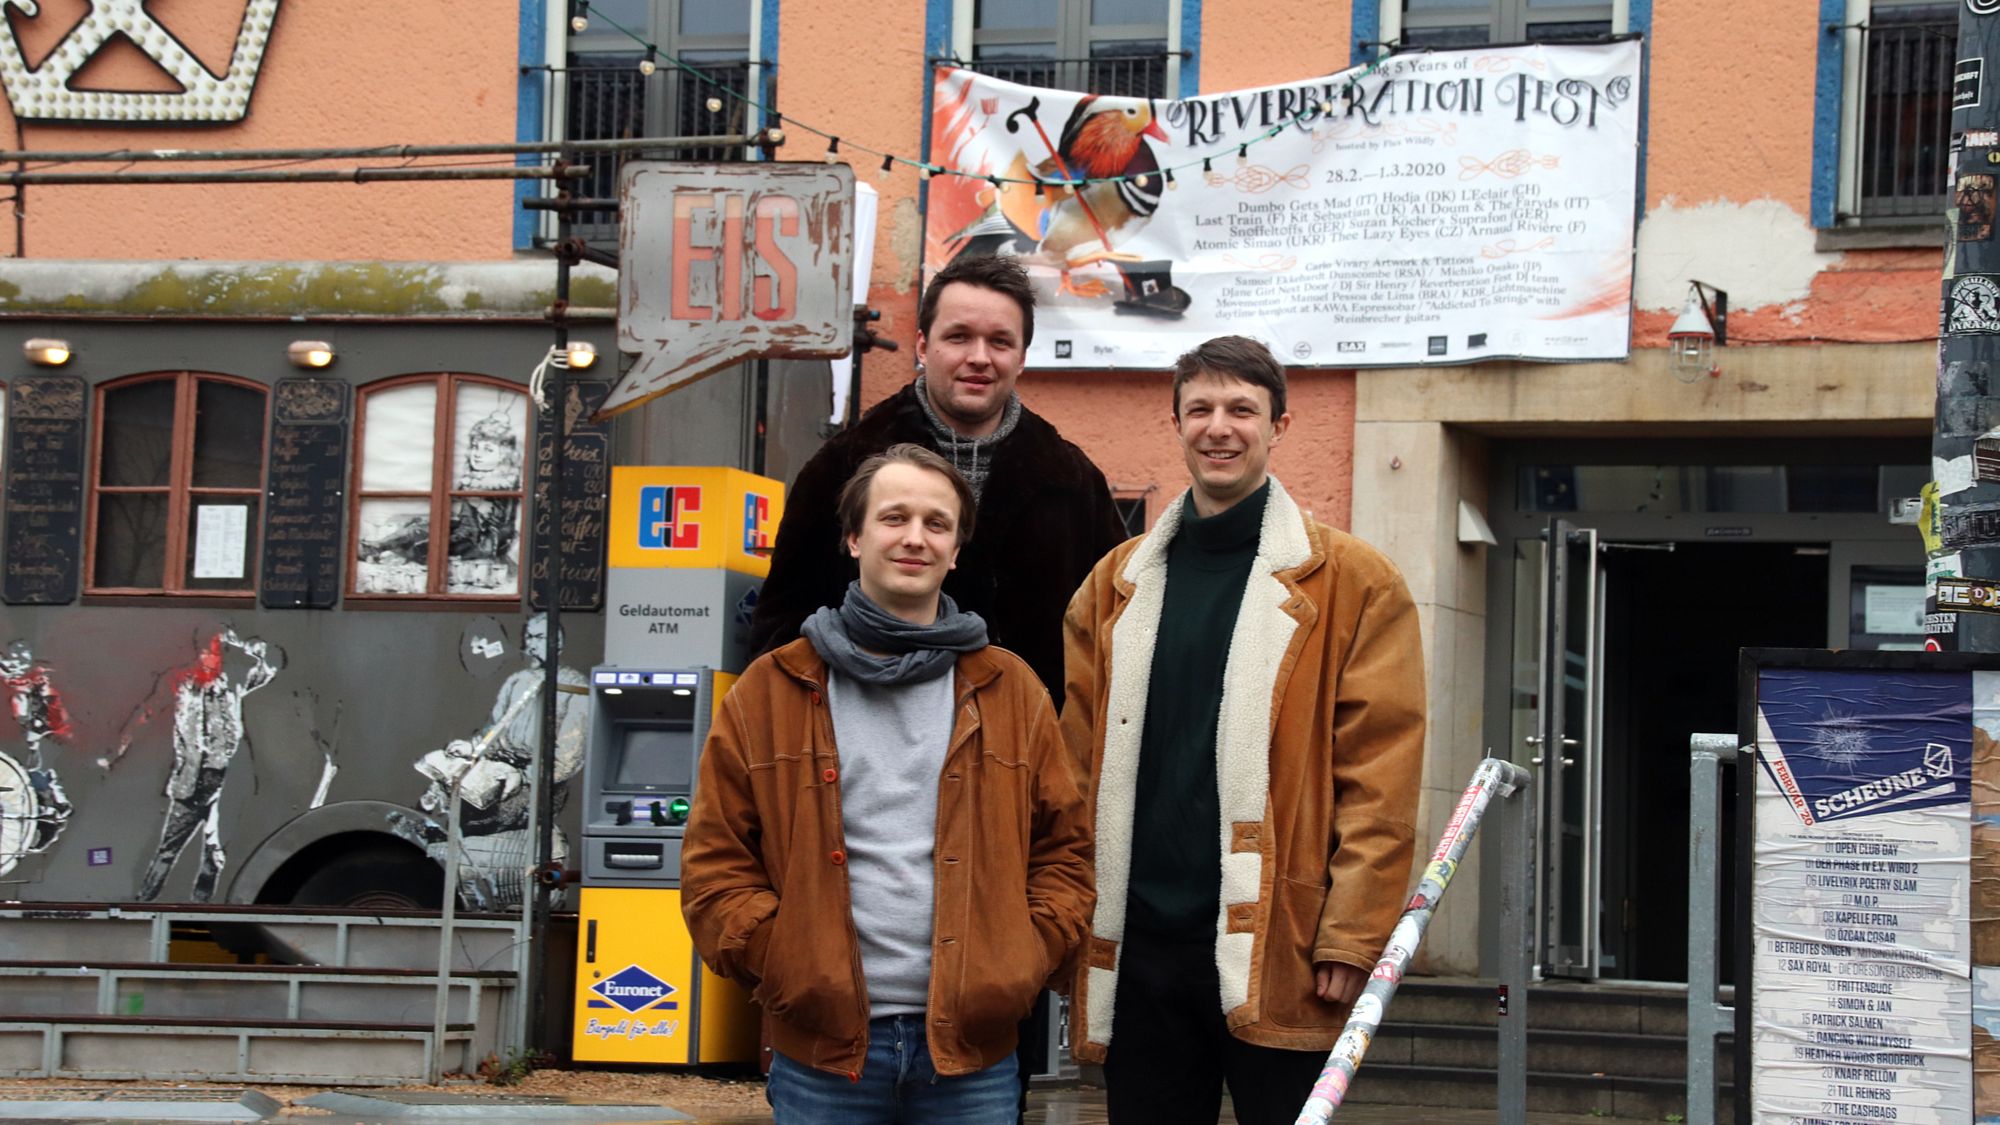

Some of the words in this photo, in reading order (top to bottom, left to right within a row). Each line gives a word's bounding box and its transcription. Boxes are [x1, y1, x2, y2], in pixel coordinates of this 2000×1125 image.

[1395, 60, 1403, 74] 5
[1409, 60, 1448, 73] Years
[1454, 57, 1469, 70] of
[1166, 75, 1483, 149] REVERBERATION
[1369, 142, 1379, 151] by
[1238, 201, 1285, 214] Dumbo
[1289, 200, 1319, 212] Gets
[1324, 197, 1351, 209] Mad
[1355, 194, 1378, 208] (IT)
[1383, 191, 1421, 206] Hodja
[1426, 190, 1456, 204] (DK)
[1512, 184, 1541, 198] (CH)
[1195, 215, 1223, 227] Last
[1226, 213, 1263, 226] Train
[1267, 211, 1285, 225] (F)
[1290, 211, 1309, 223] Kit
[1313, 206, 1370, 221] Sebastian
[1375, 204, 1407, 219] (UK)
[1431, 202, 1469, 215] Doum
[1474, 200, 1487, 212] &
[1489, 200, 1512, 211] The
[1564, 197, 1590, 210] (IT)
[1308, 221, 1345, 236] (GER)
[1349, 218, 1386, 230] Suzan
[1511, 207, 1549, 221] (GER)
[1193, 238, 1239, 251] Atomic
[1286, 235, 1326, 249] (UKR)
[1330, 231, 1359, 243] Thee
[1363, 227, 1394, 242] Lazy
[1401, 227, 1430, 242] Eyes
[1436, 225, 1463, 240] (CZ)
[1468, 222, 1513, 236] Arnaud
[1567, 221, 1586, 234] (F)
[671, 194, 800, 321] EIS
[1373, 257, 1417, 267] Artwork
[1235, 276, 1273, 286] Samuel
[1356, 280, 1371, 290] Sir
[1376, 278, 1407, 290] Henry
[1420, 276, 1490, 289] Reverberation
[1371, 290, 1384, 300] de
[1388, 289, 1414, 300] Lima
[1300, 304, 1310, 313] at
[1313, 302, 1348, 313] KAWA
[619, 604, 710, 617] Geldautomat
[648, 623, 679, 634] ATM
[1774, 760, 1805, 809] FEBRUAR
[1815, 767, 1927, 818] SCHEUNE
[1835, 843, 1858, 855] OPEN
[1859, 844, 1881, 856] CLUB
[1882, 845, 1898, 857] DAY
[1815, 860, 1832, 870] DER
[1888, 863, 1911, 874] WIRD
[1912, 863, 1918, 874] 2
[1818, 876, 1858, 889] LIVELYRIX
[1860, 878, 1892, 890] POETRY
[1893, 879, 1917, 892] SLAM
[1835, 911, 1870, 925] KAPELLE
[1871, 913, 1898, 926] PETRA
[1775, 941, 1820, 955] BETREUTES
[1821, 943, 1851, 957] SINGEN
[1788, 959, 1804, 972] SAX
[1806, 960, 1832, 974] ROYAL
[604, 981, 663, 996] Euronet
[1837, 980, 1893, 995] FRITTENBUDE
[1837, 998, 1866, 1010] SIMON
[1867, 999, 1875, 1011] &
[1876, 1000, 1892, 1012] JAN
[1812, 1014, 1847, 1028] PATRICK
[1848, 1015, 1883, 1029] SALMEN
[1816, 1032, 1854, 1046] DANCING
[1880, 1036, 1912, 1049] MYSELF
[1805, 1049, 1841, 1061] HEATHER
[1876, 1053, 1925, 1066] BRODERICK
[1834, 1067, 1862, 1080] KNARF
[1837, 1085, 1854, 1098] TILL
[1855, 1086, 1891, 1100] REINERS
[1834, 1103, 1849, 1115] THE
[1850, 1104, 1897, 1119] CASHBAGS
